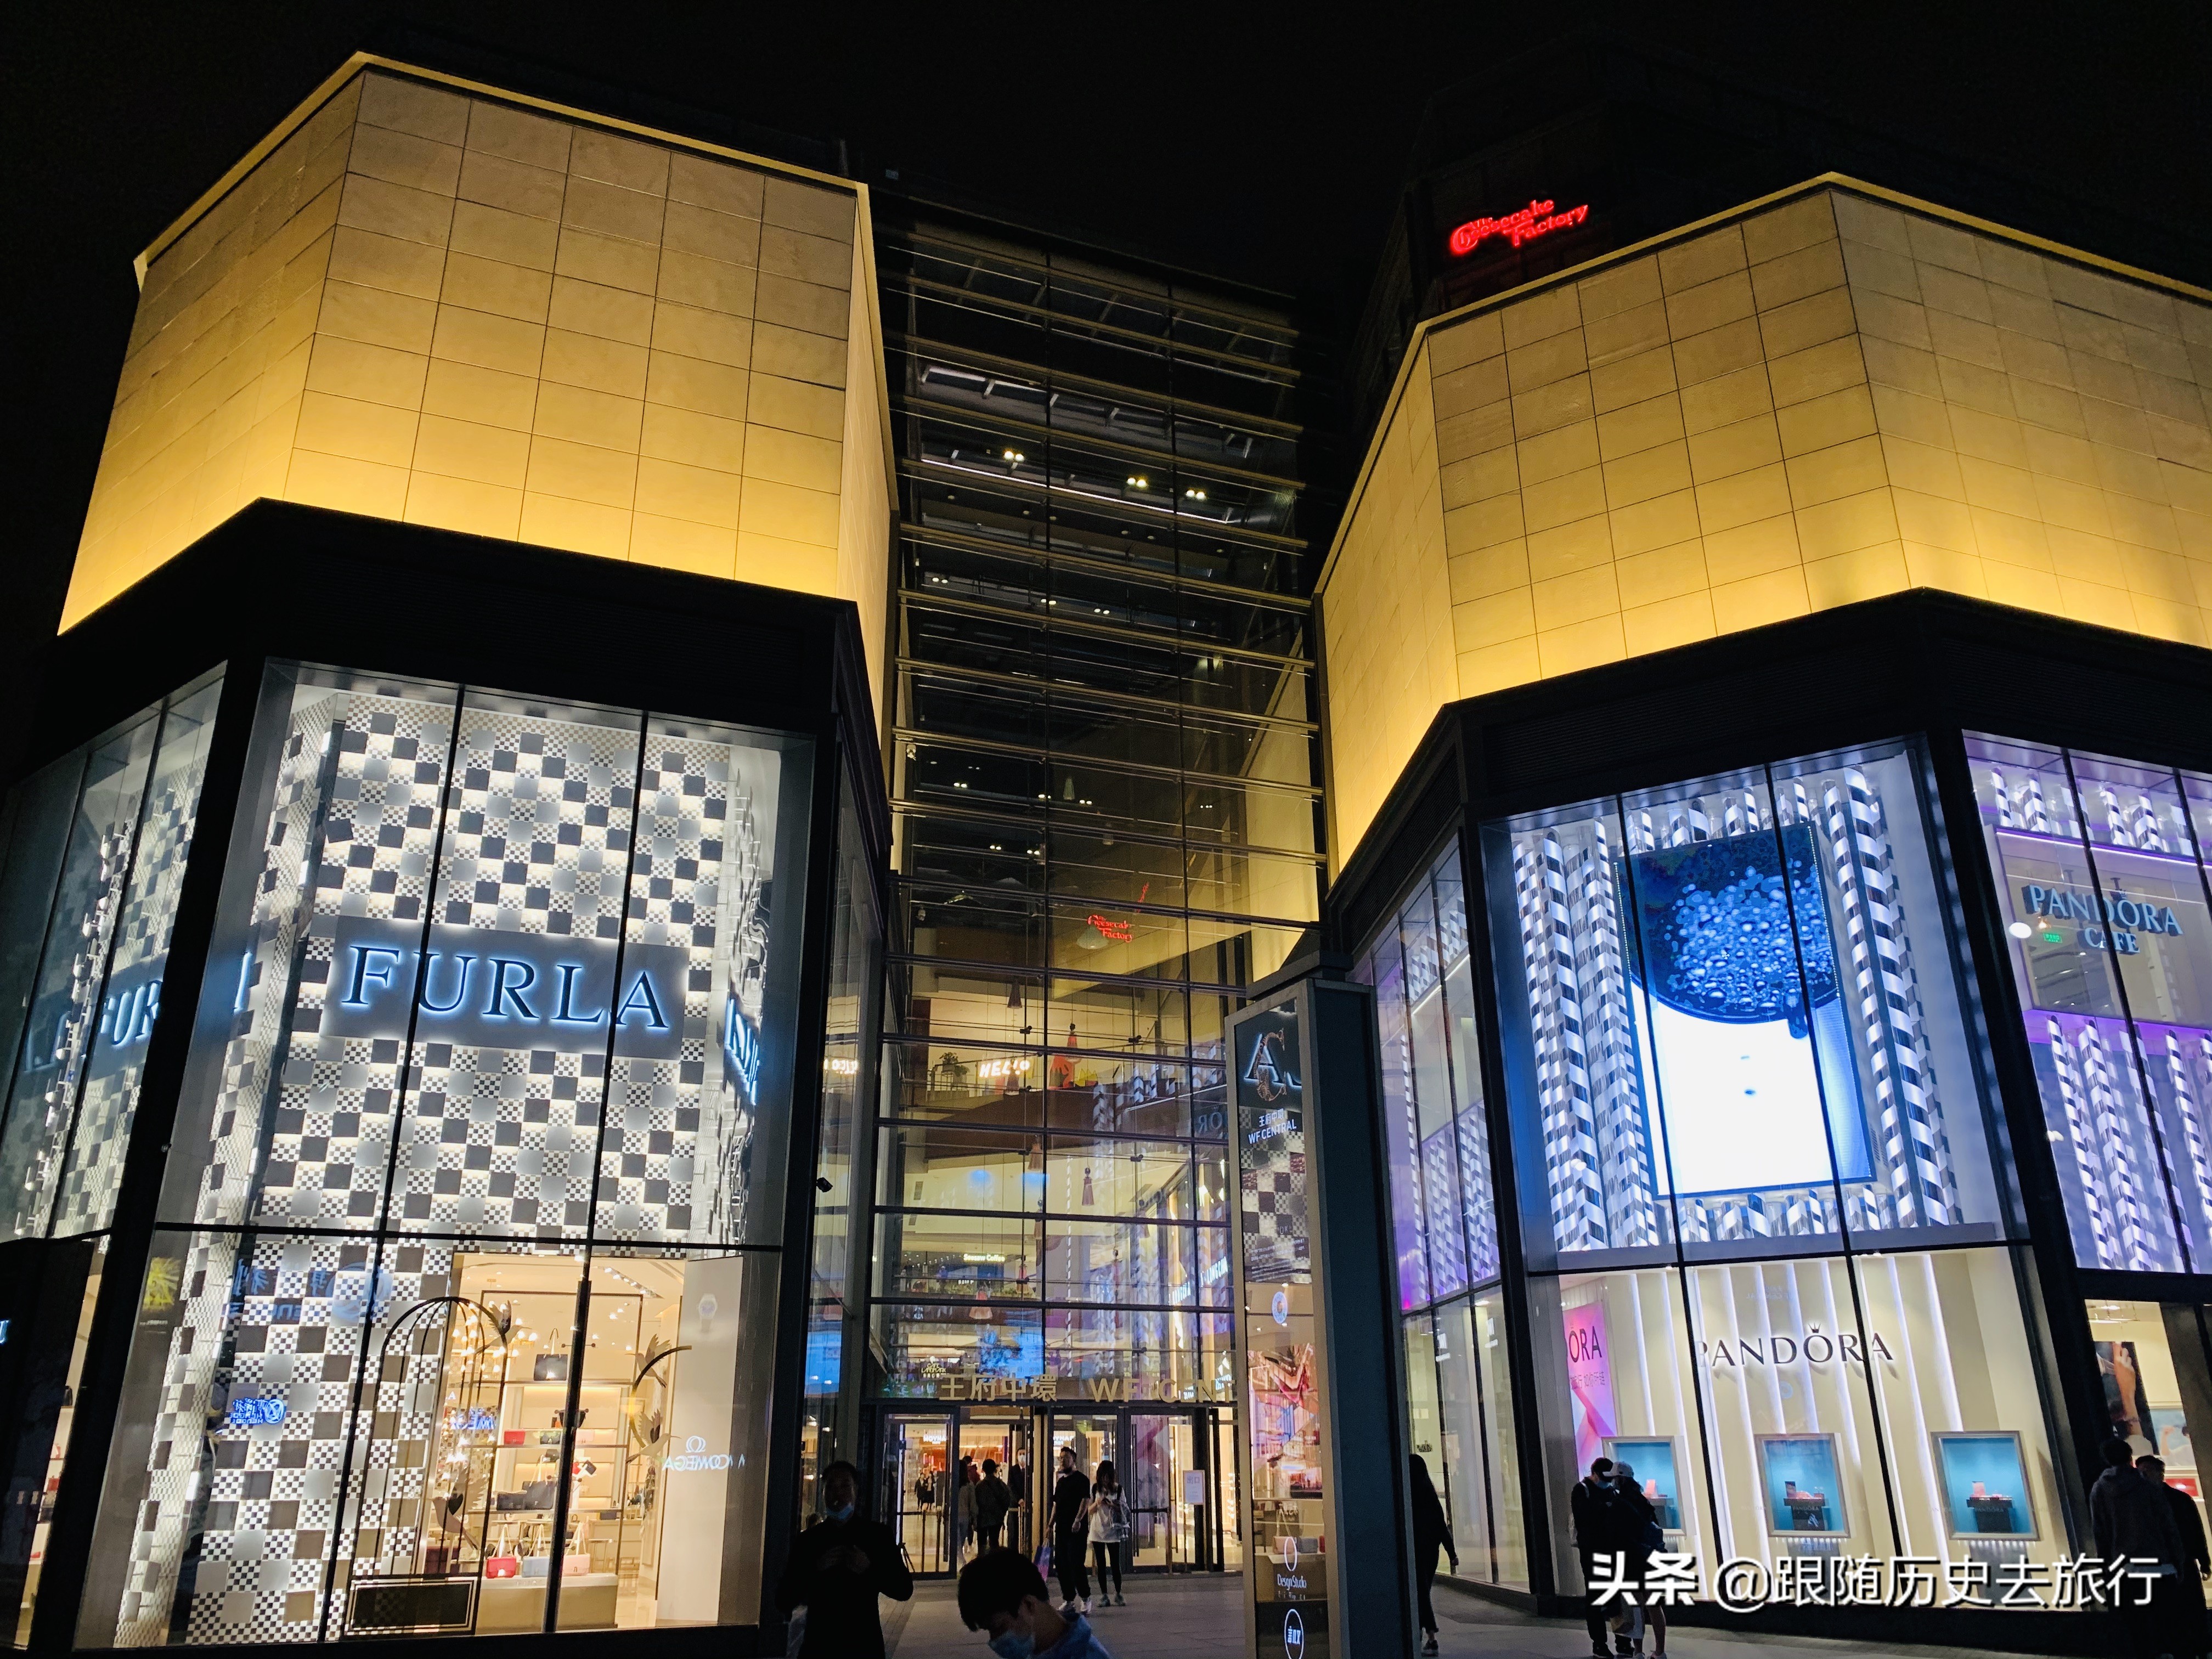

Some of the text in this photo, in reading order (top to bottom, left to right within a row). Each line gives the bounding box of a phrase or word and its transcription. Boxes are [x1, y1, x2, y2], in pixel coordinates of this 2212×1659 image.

[1451, 199, 1555, 255] Cheesecake
[1502, 204, 1589, 247] Factory
[341, 945, 670, 1029] FURLA
[1261, 1119, 1297, 1140] CENTRAL
[939, 1374, 1058, 1402] 王府中環
[1088, 1378, 1140, 1403] WF
